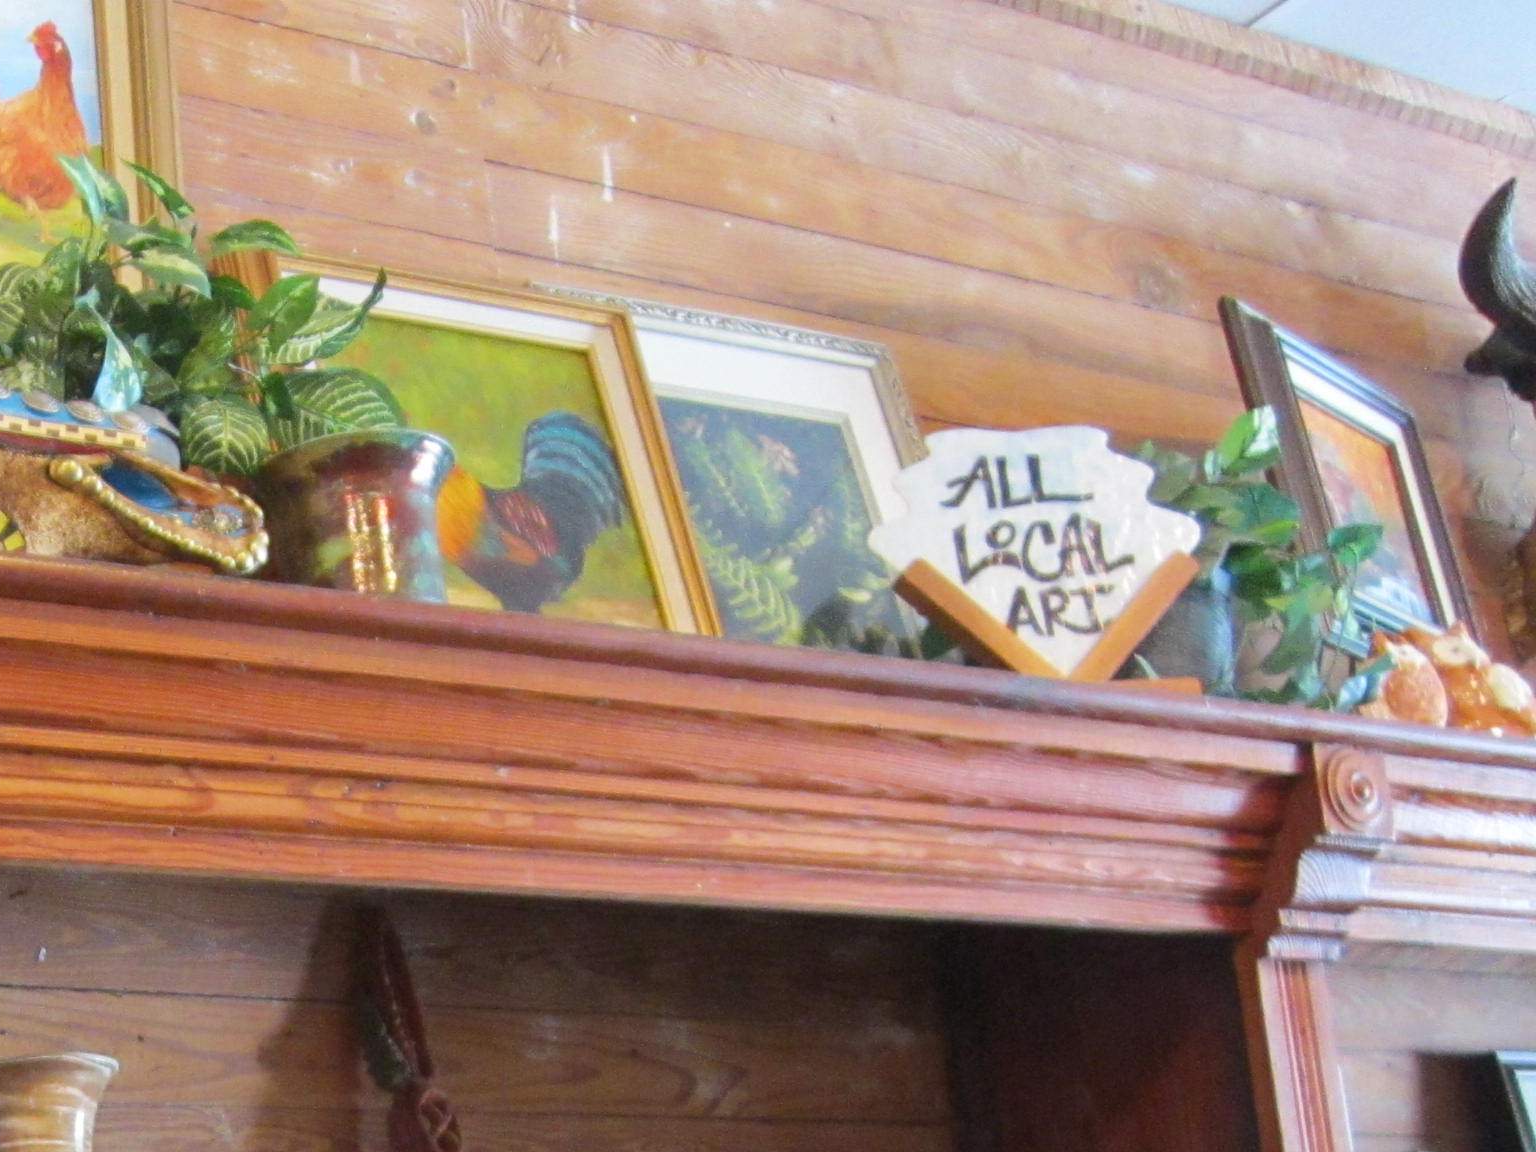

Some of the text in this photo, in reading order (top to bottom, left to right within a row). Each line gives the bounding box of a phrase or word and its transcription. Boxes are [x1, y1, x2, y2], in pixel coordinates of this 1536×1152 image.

[939, 454, 1094, 508] ALL
[953, 513, 1135, 583] LOCAL
[1006, 585, 1116, 637] ART
